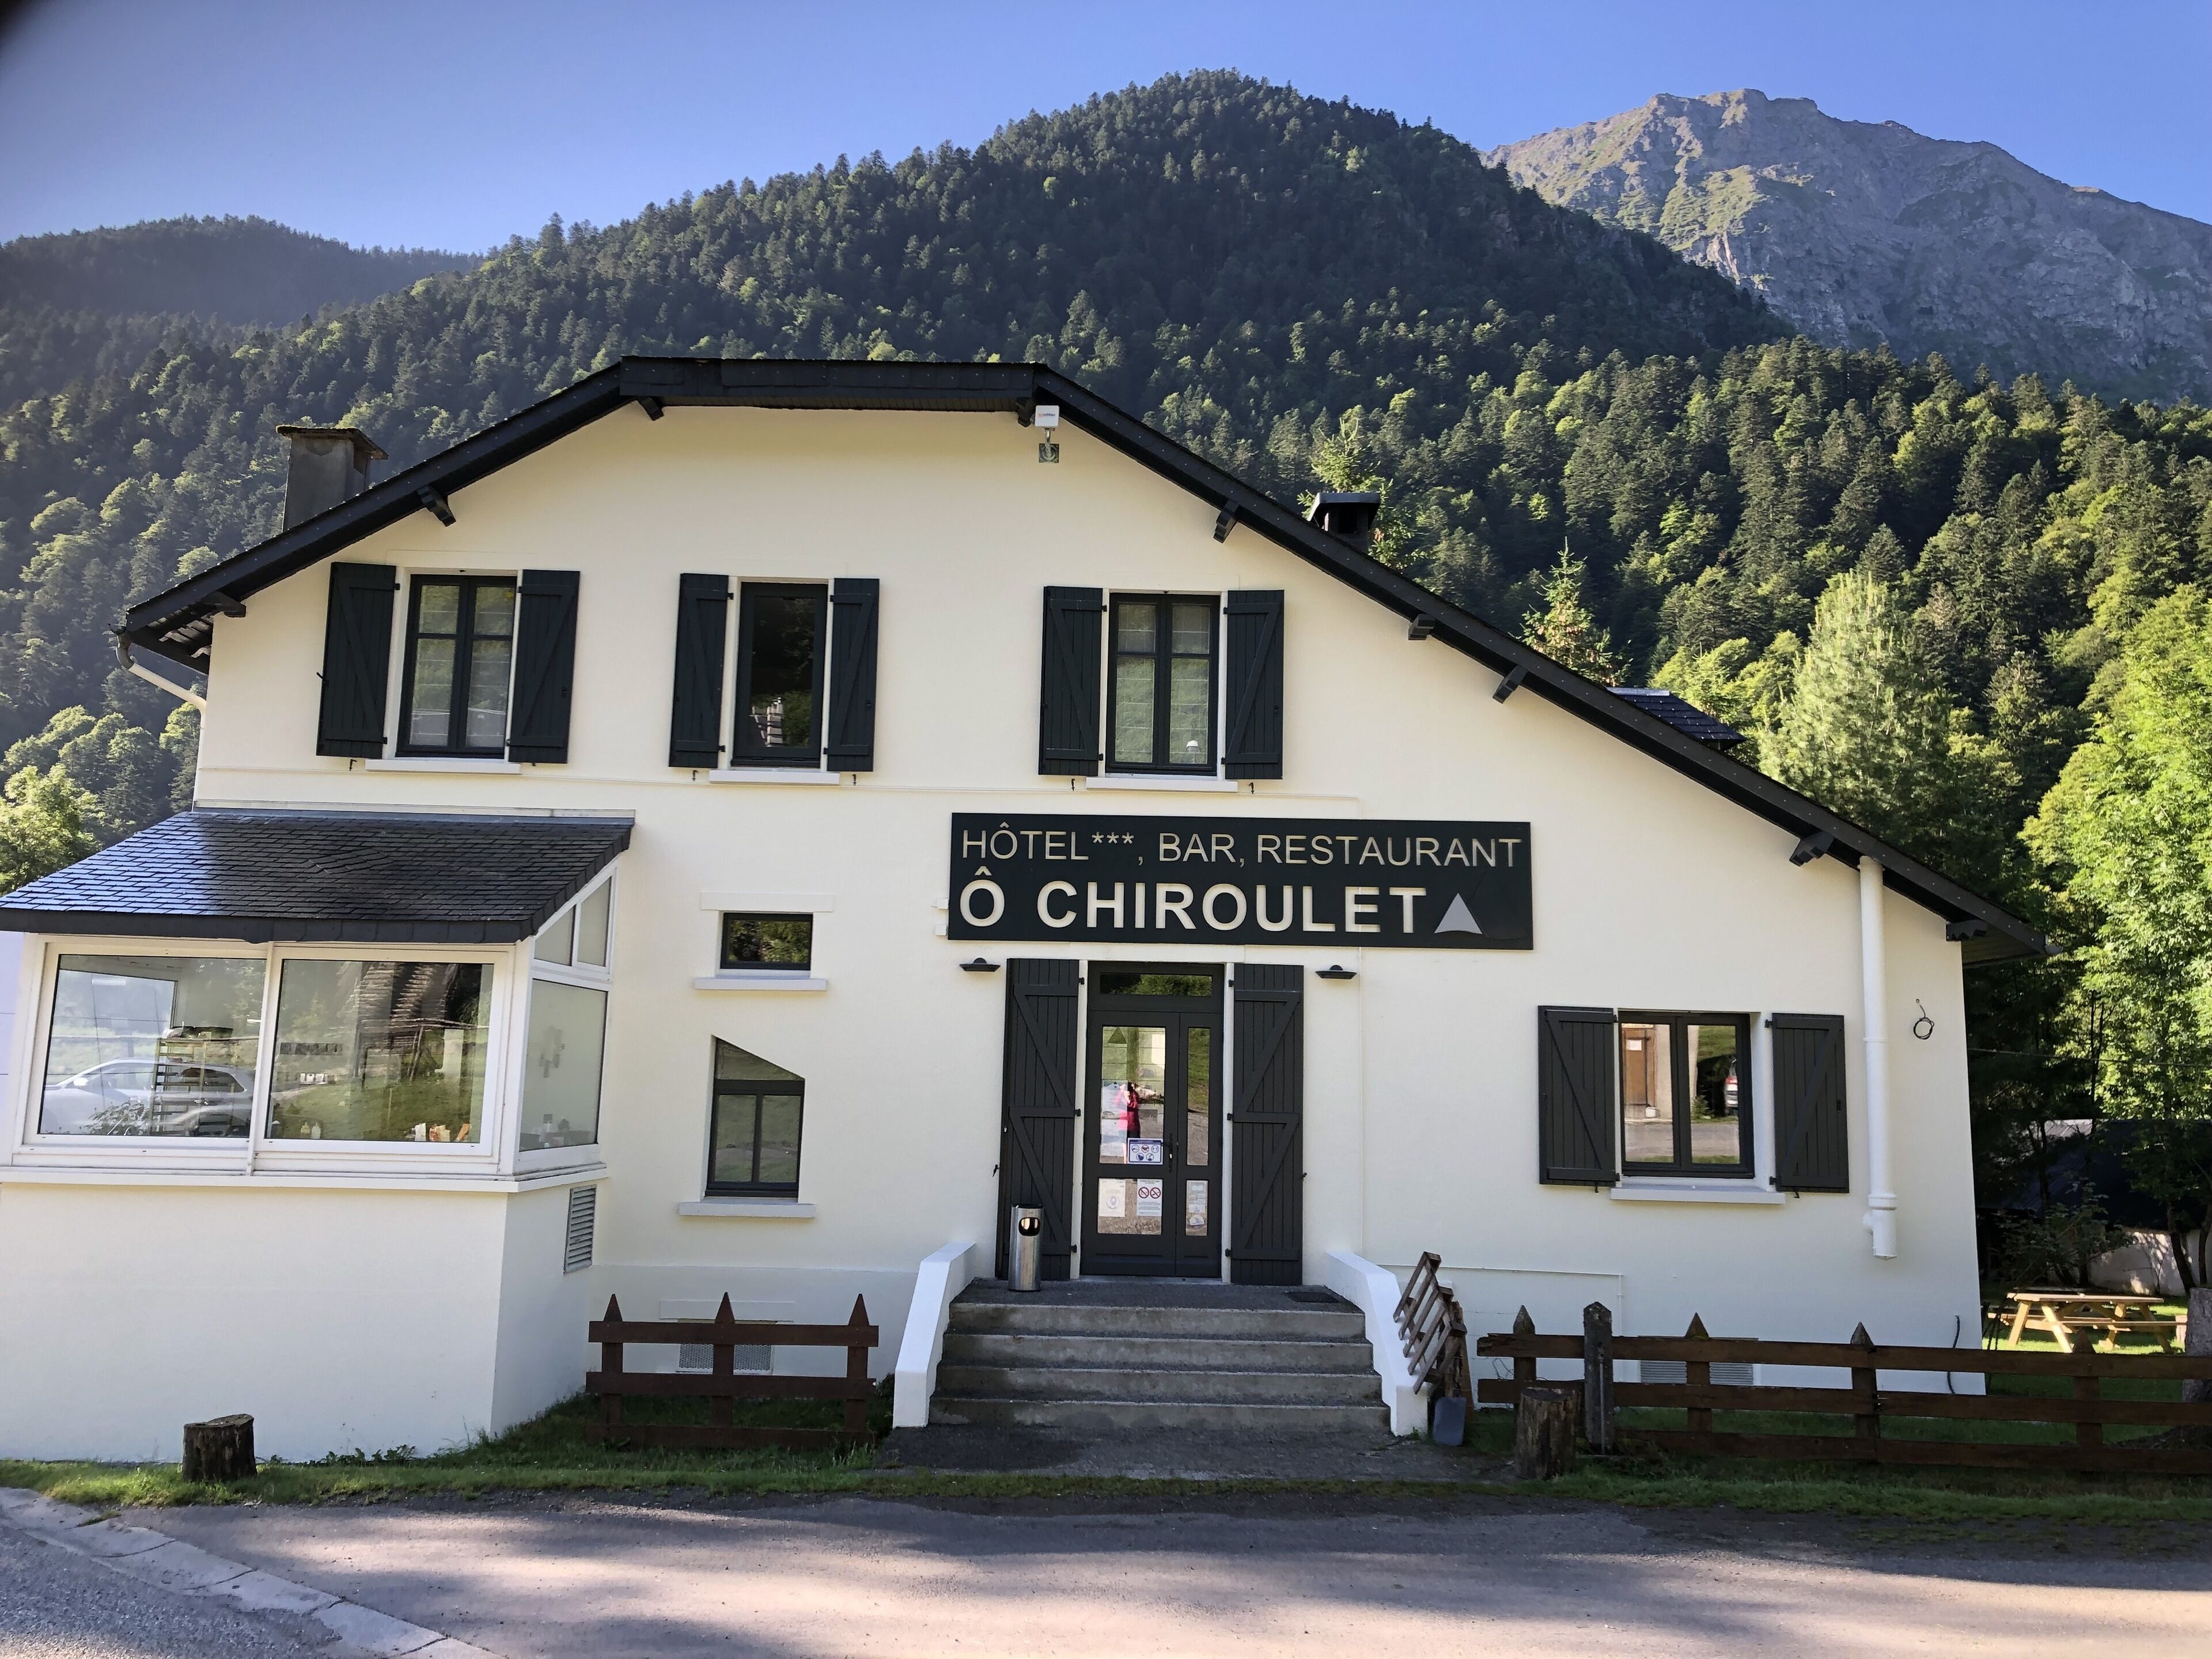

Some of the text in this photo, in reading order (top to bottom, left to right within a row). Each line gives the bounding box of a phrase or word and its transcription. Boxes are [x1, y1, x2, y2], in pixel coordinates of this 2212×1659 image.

[1158, 832, 1245, 868] BAR,
[1257, 834, 1522, 868] RESTAURANT
[959, 865, 1427, 934] Ô CHIROULET
